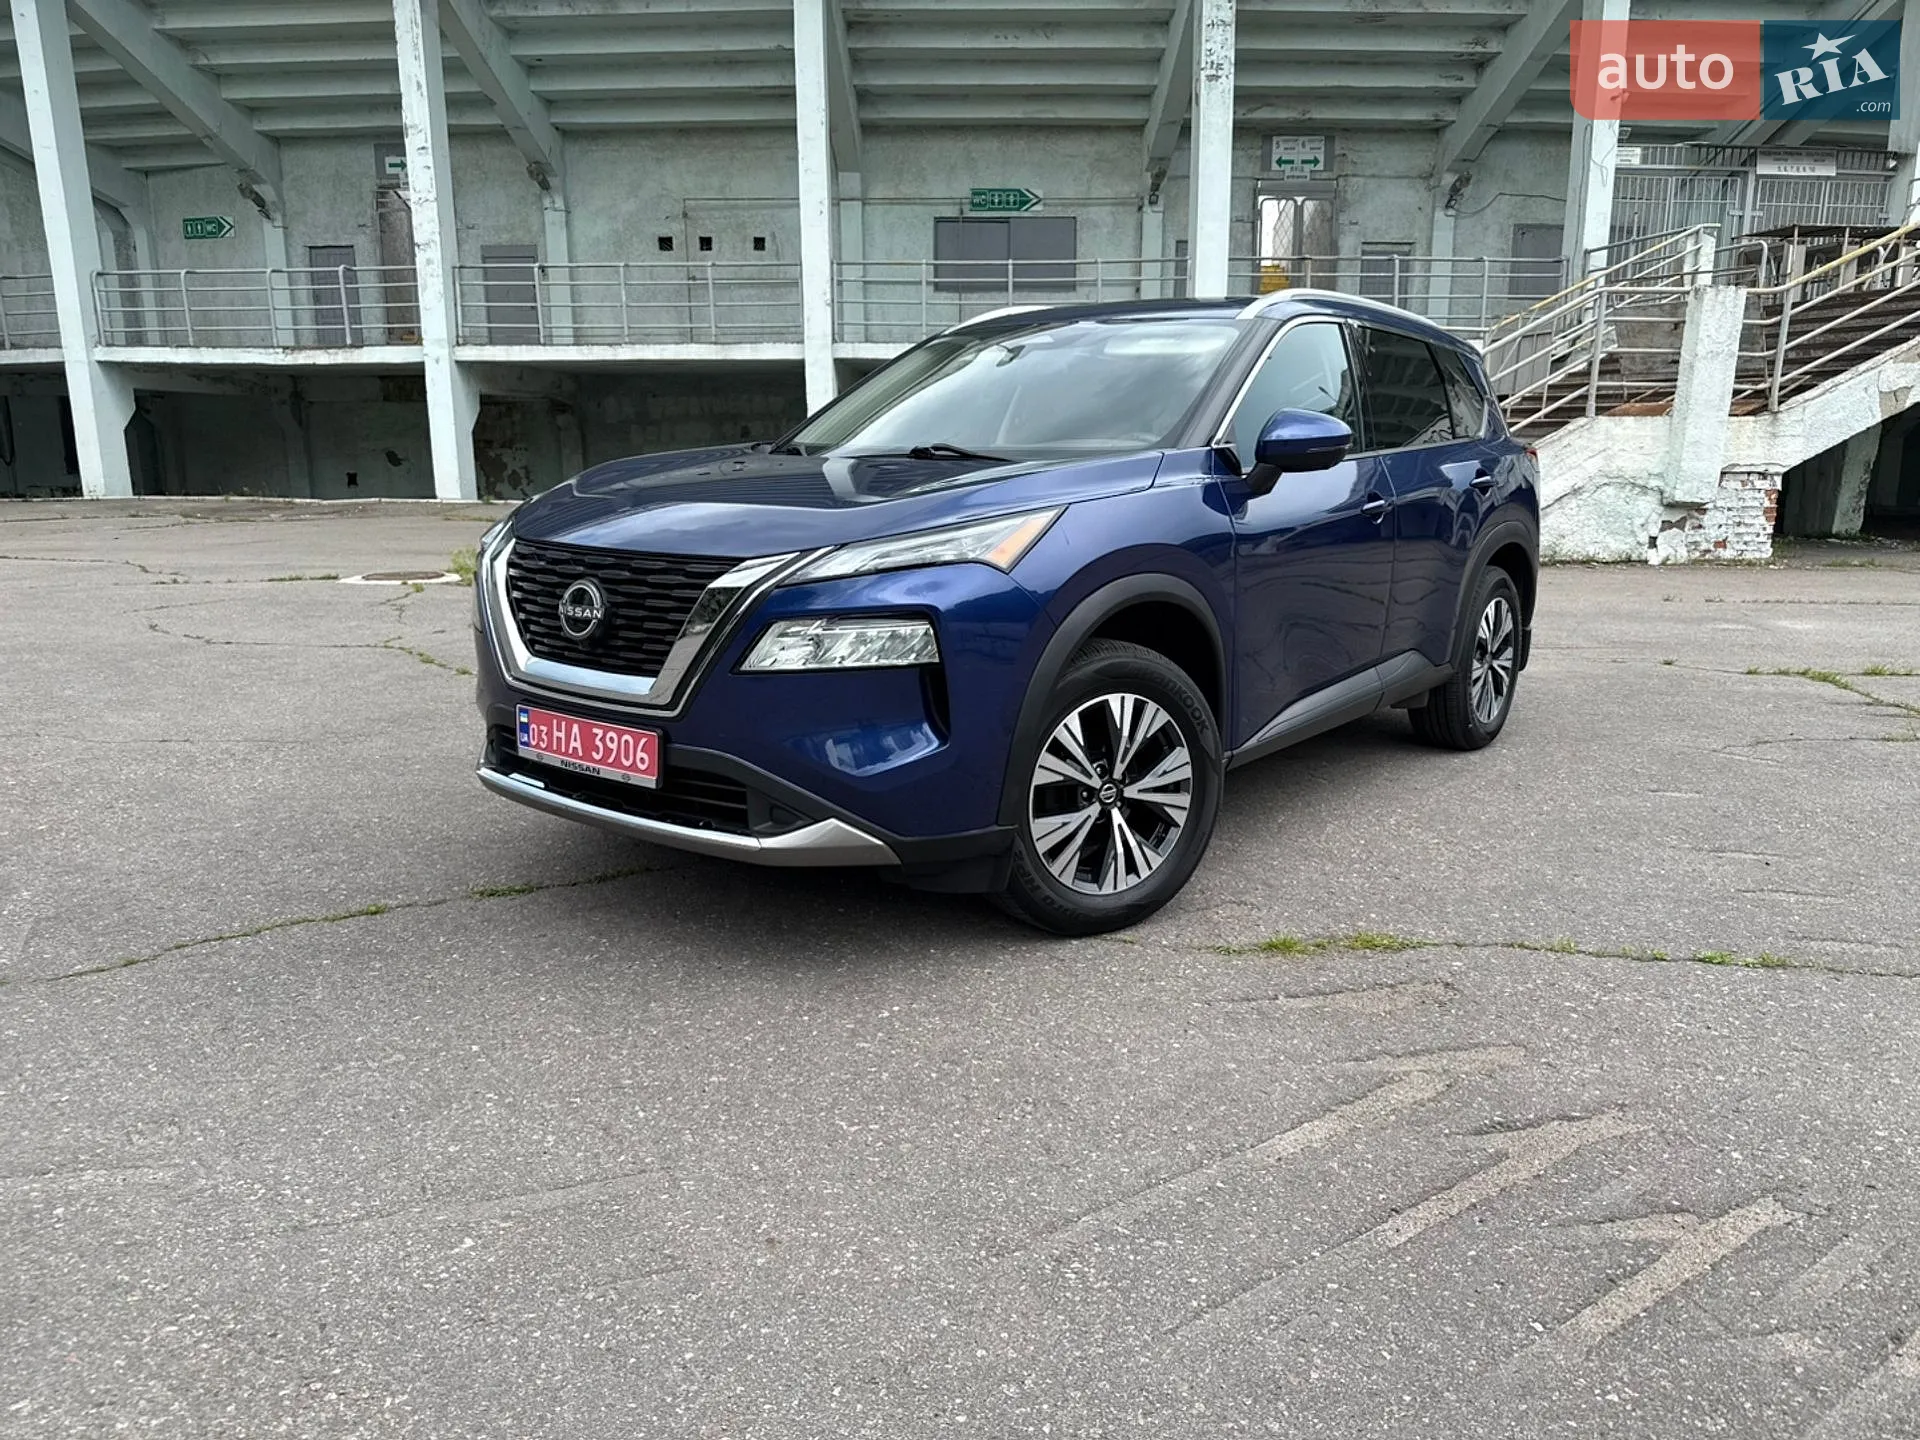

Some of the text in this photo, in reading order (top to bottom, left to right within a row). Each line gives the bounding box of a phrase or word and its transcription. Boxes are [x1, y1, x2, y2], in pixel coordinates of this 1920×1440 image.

[973, 195, 986, 205] WC
[206, 223, 217, 233] WC
[529, 718, 650, 771] 03 HA 3906
[560, 759, 601, 776] NISSAN
